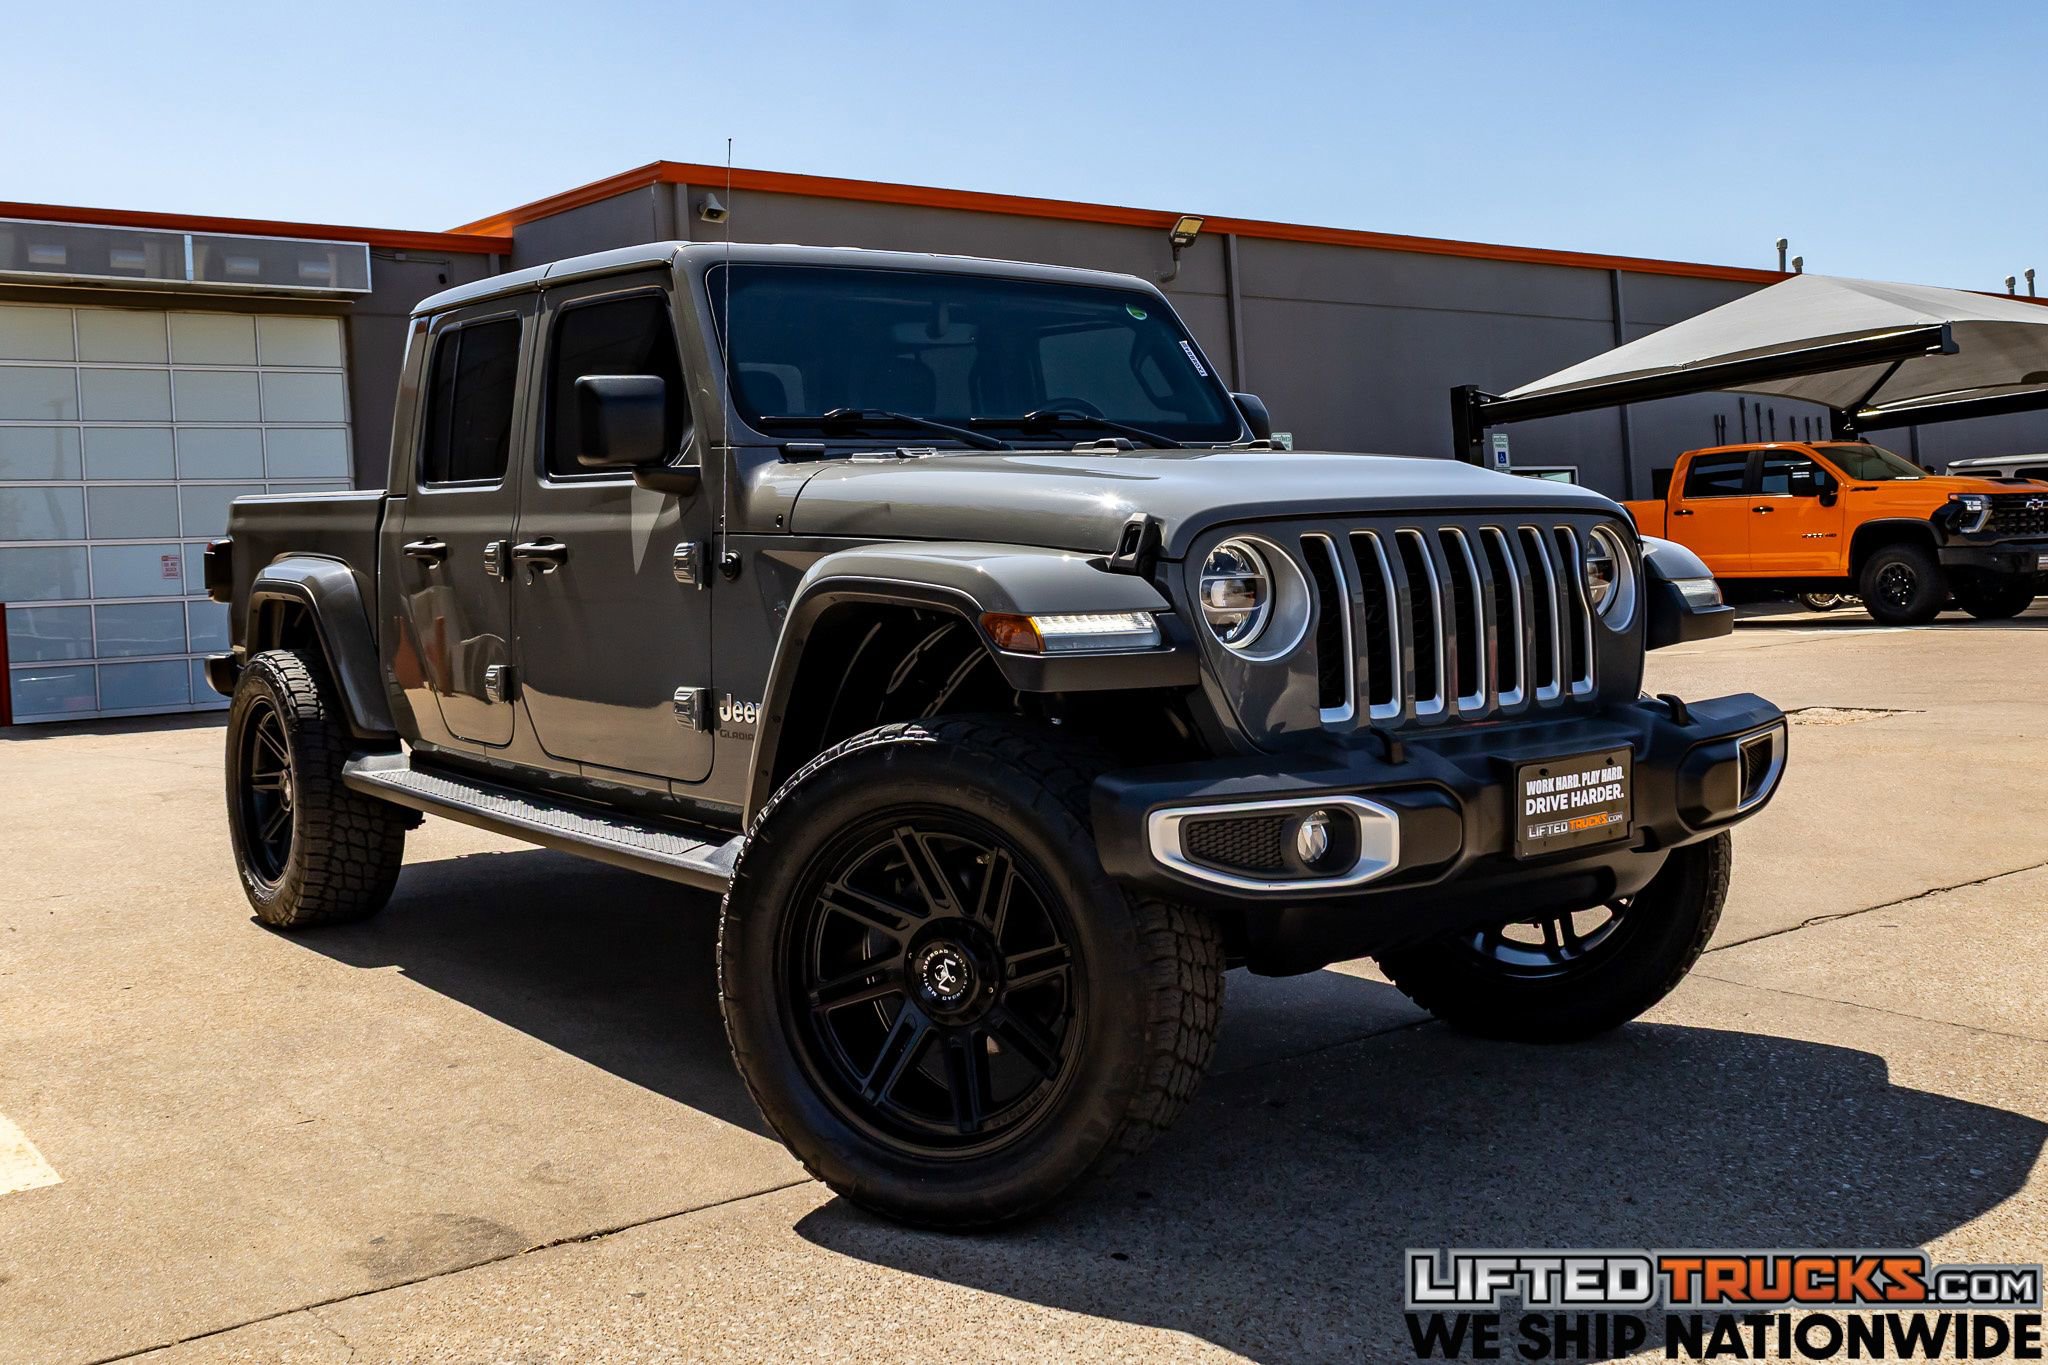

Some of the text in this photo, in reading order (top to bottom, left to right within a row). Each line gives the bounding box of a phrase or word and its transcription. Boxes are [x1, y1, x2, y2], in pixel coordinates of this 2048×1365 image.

[720, 729, 755, 741] GLADIA
[1526, 765, 1624, 796] WORK HARD. PLAY HARD.
[1525, 783, 1624, 816] DRIVE HARDER.
